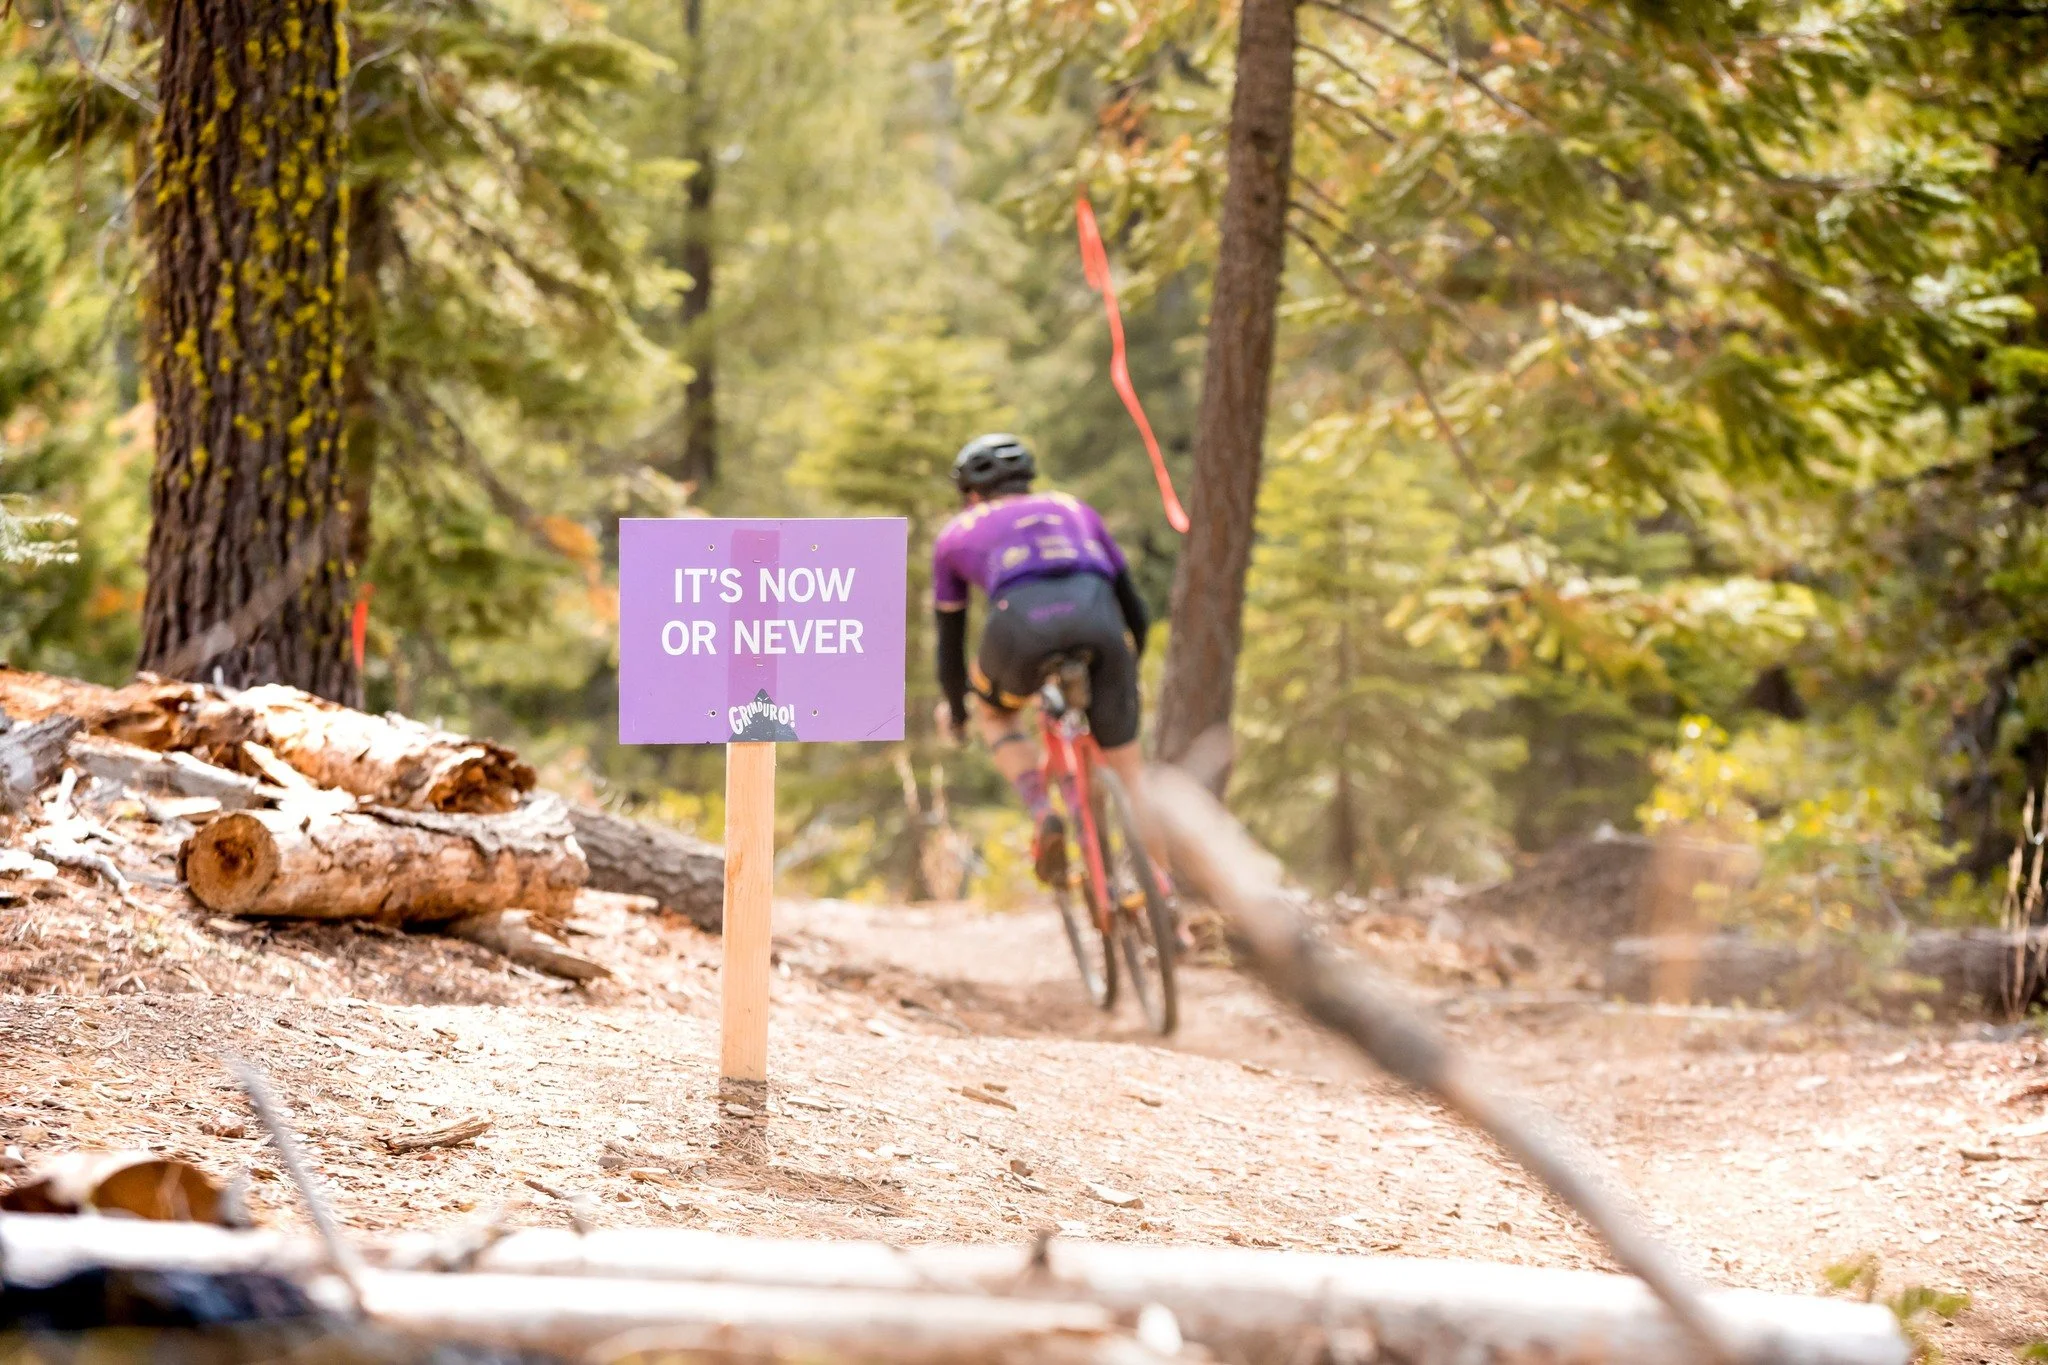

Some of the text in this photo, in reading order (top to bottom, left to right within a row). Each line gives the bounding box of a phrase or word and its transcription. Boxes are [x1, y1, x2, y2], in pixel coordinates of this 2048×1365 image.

[674, 567, 856, 603] IT'S NOW
[661, 619, 864, 655] OR NEVER
[728, 701, 796, 735] GRINDURO!
